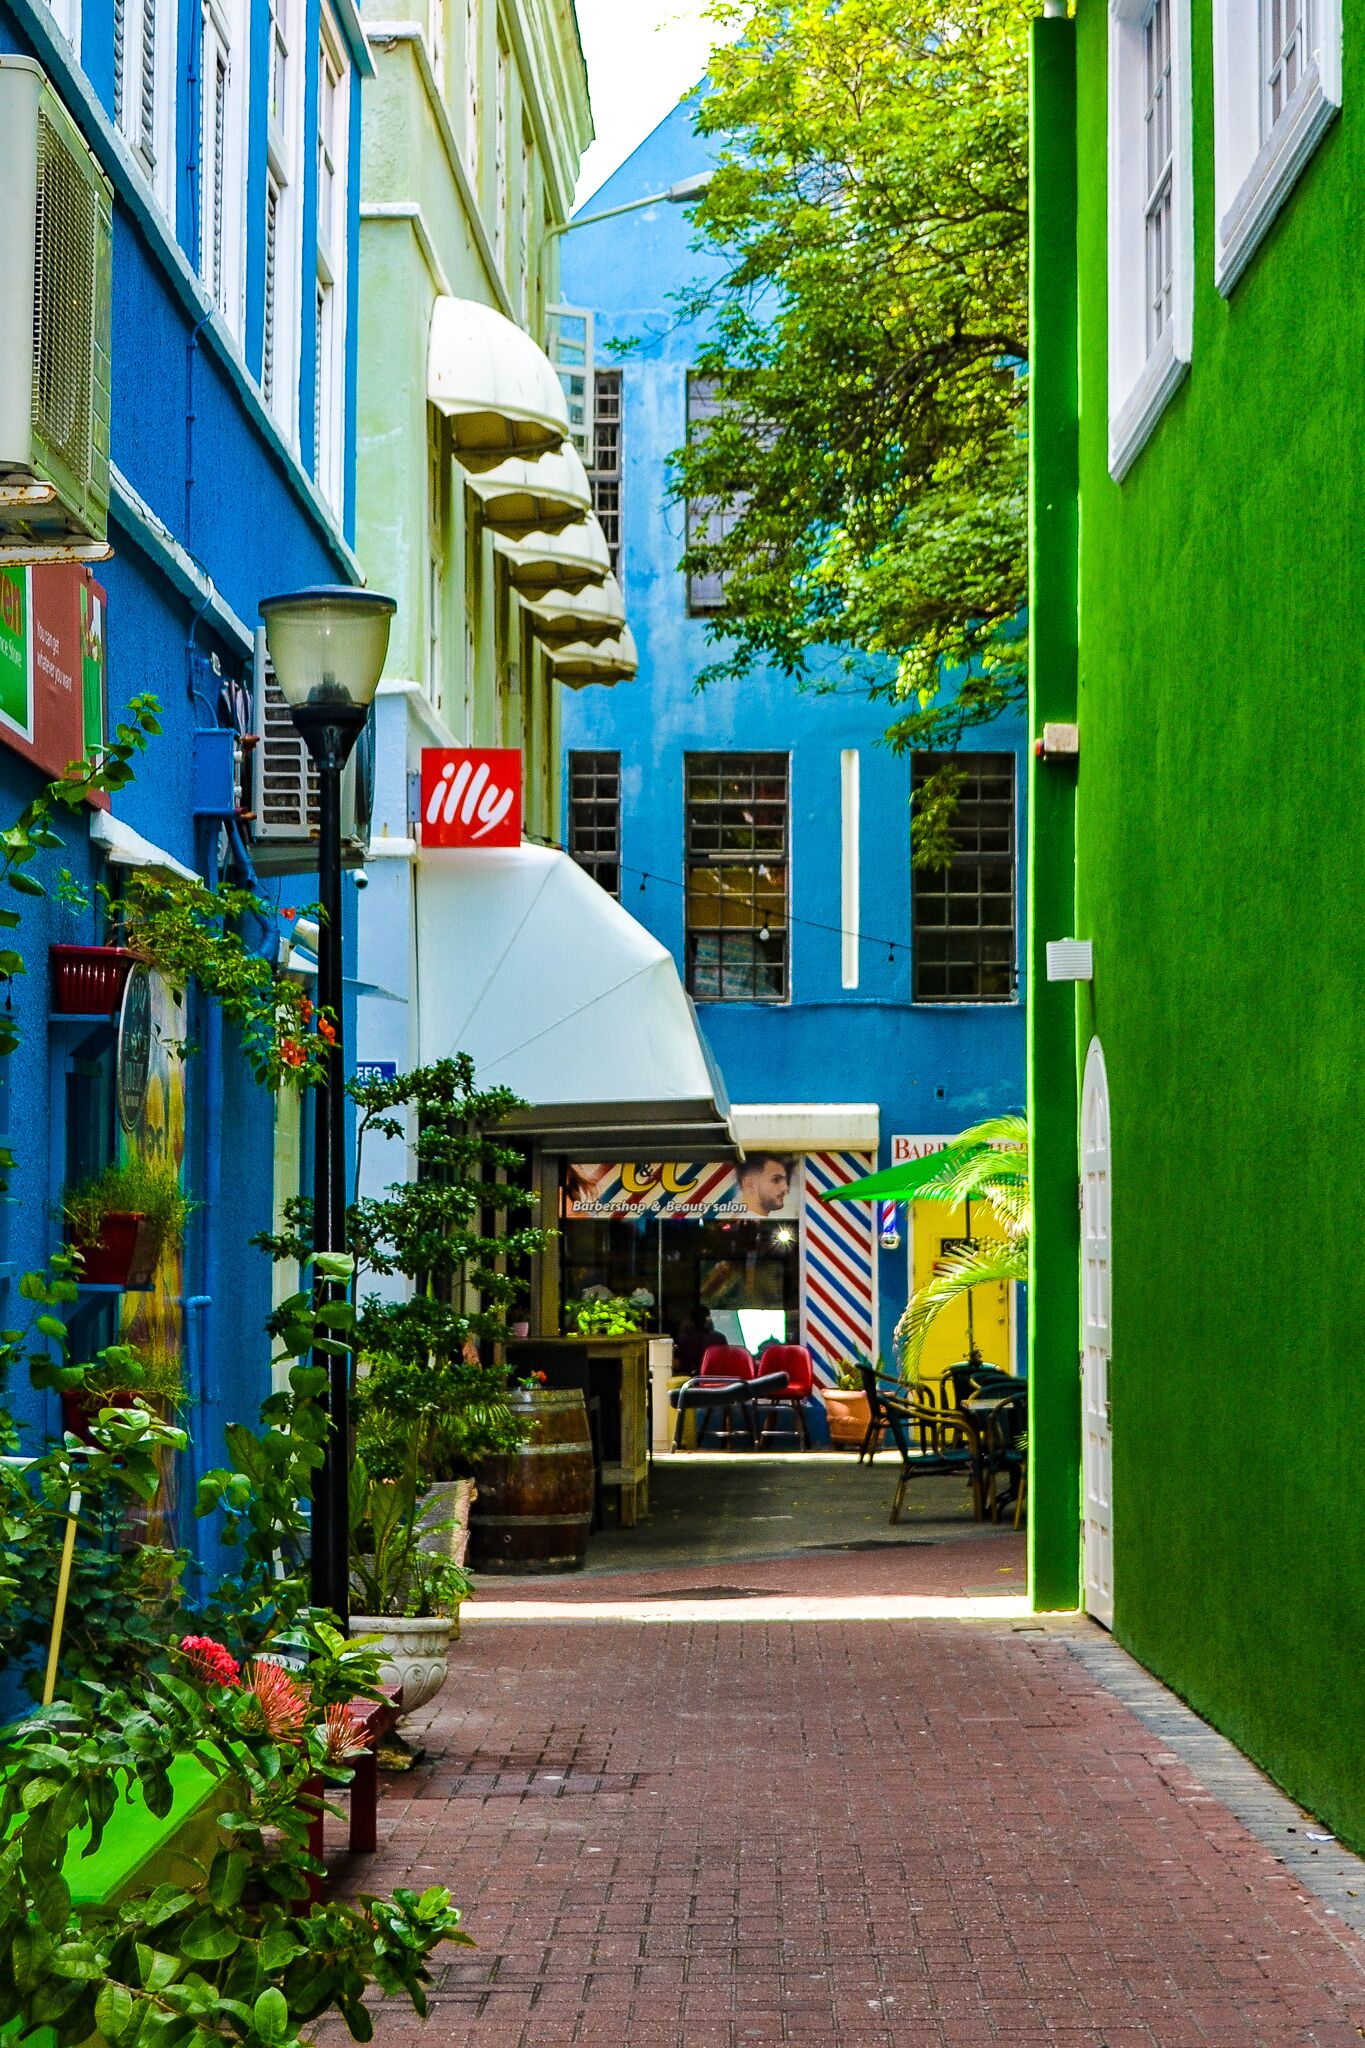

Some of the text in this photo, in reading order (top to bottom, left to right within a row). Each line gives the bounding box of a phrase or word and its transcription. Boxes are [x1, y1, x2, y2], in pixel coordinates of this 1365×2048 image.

[9, 639, 22, 668] Store
[426, 760, 514, 839] illy
[573, 1200, 747, 1214] Barbershop & Beauty salon
